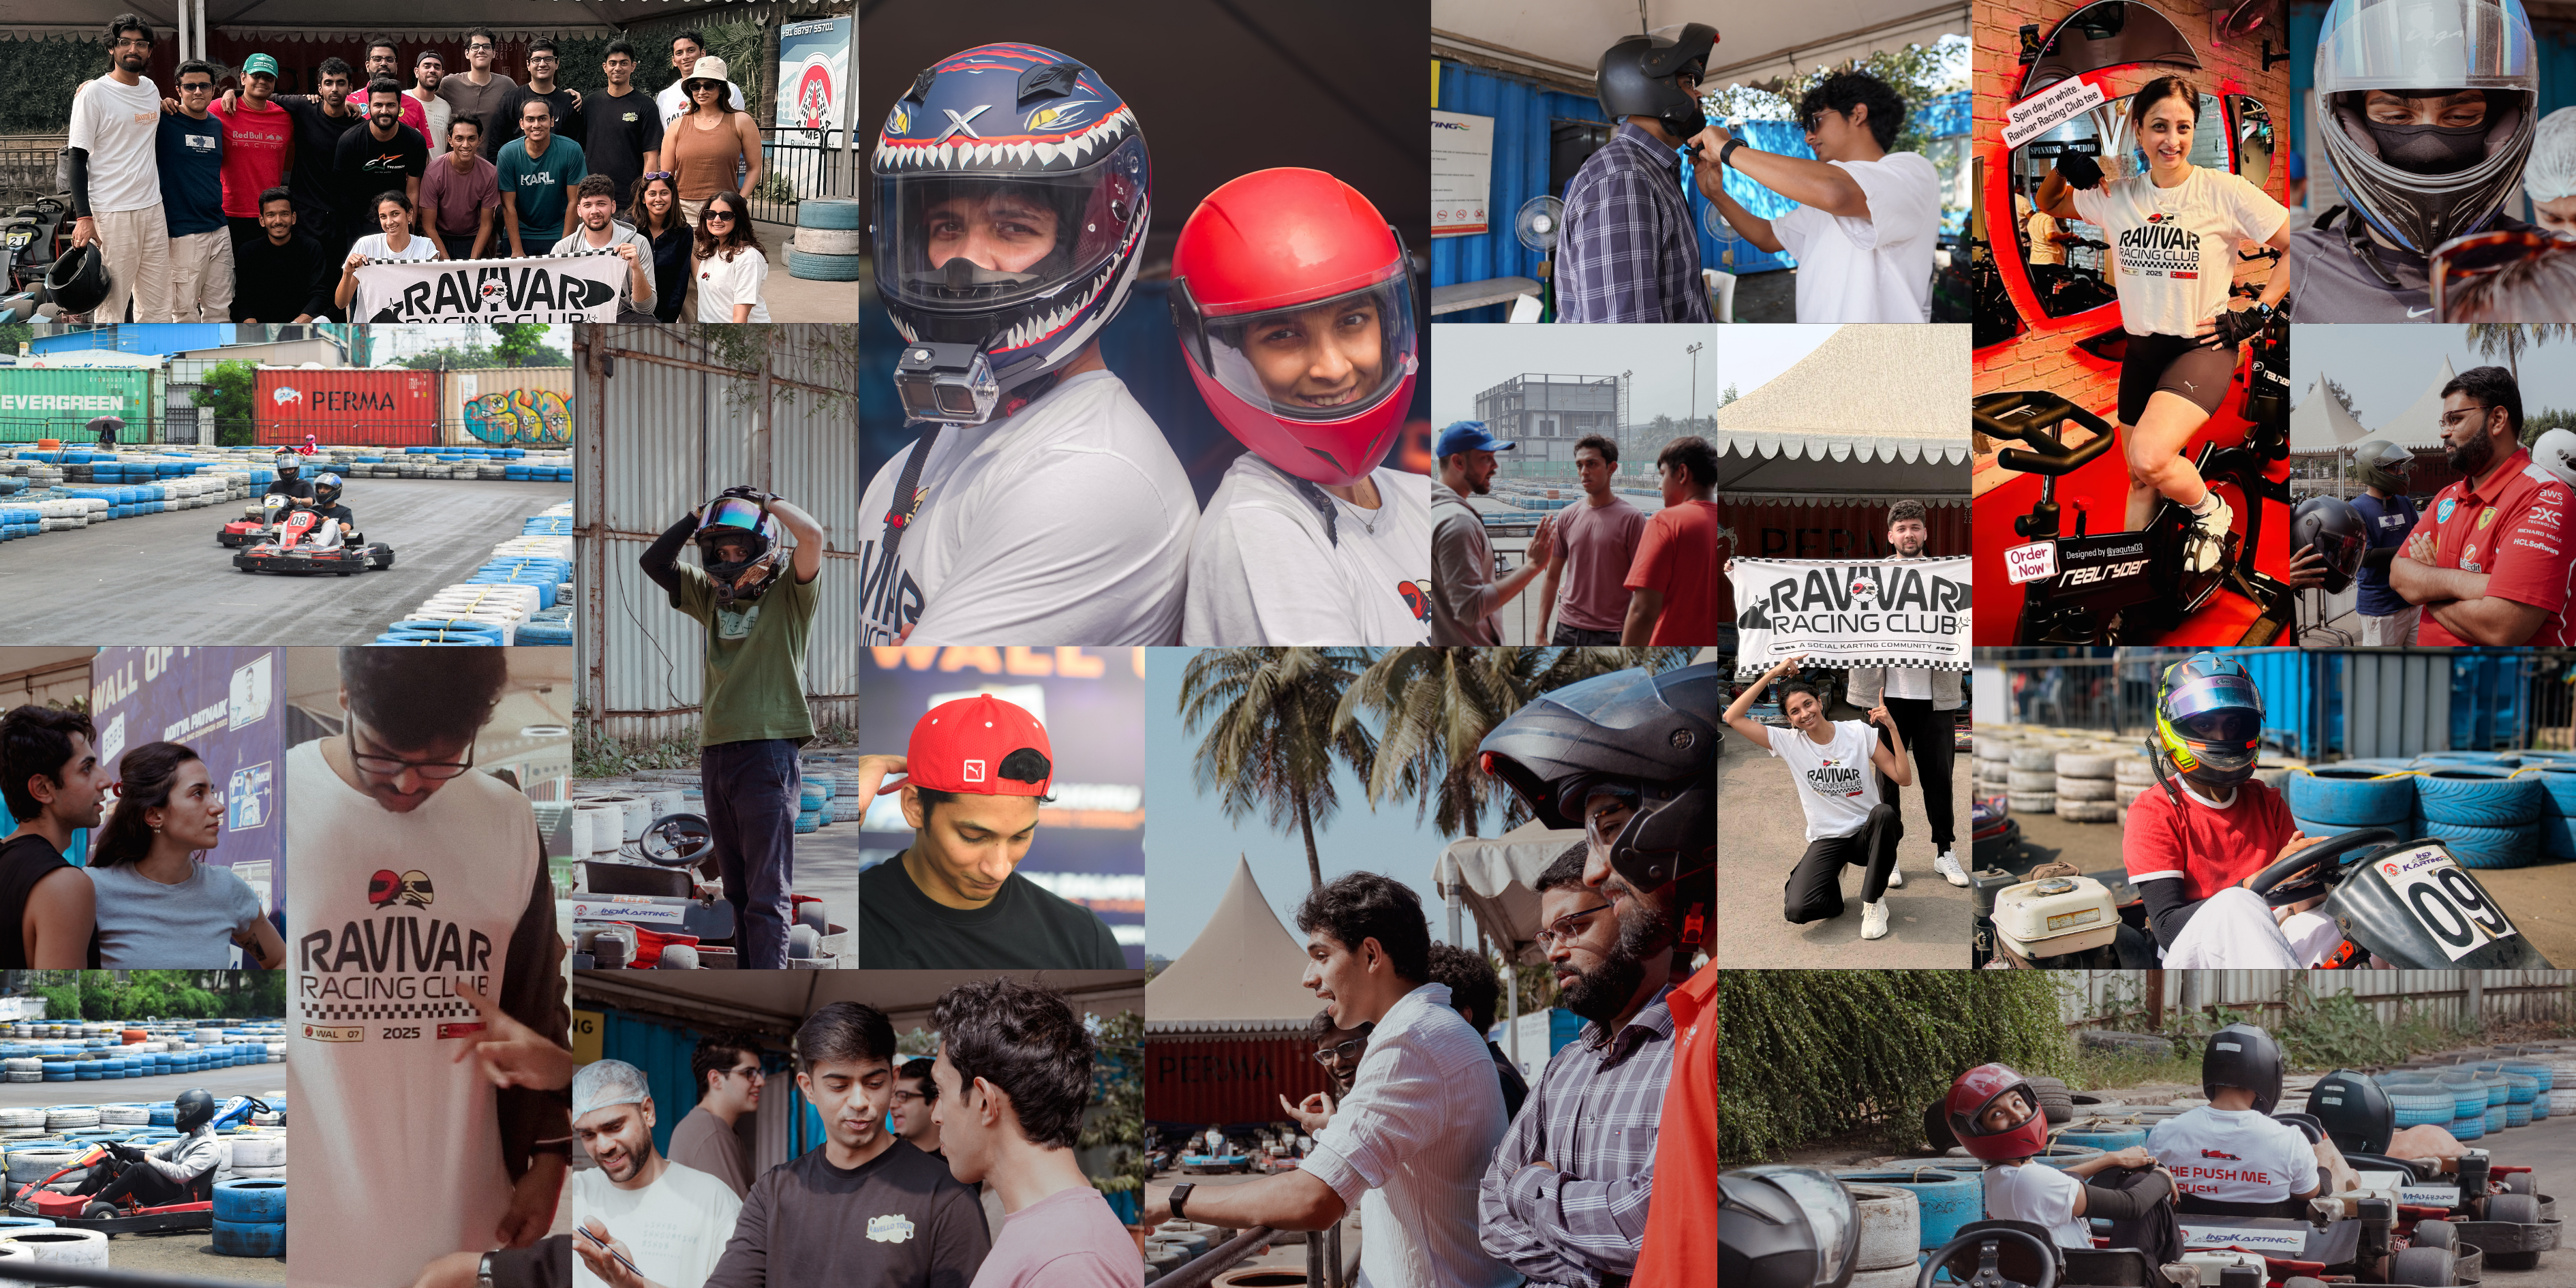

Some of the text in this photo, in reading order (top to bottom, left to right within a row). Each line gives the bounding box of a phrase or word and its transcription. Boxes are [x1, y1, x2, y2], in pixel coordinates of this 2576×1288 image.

[782, 22, 834, 37] +91 88797 55701
[232, 130, 263, 140] Red Bull
[2029, 145, 2061, 155] SPINNING
[520, 170, 555, 186] KARL
[10, 236, 27, 247] 21
[2119, 225, 2201, 251] RAVIVAR
[2119, 247, 2200, 262] RACING CLUB
[1, 395, 124, 411] EVERGREEN
[311, 391, 396, 411] PERMA
[2539, 489, 2563, 501] aws
[290, 516, 307, 526] 08
[2529, 506, 2563, 526] DXC
[2527, 519, 2560, 531] TECHNOLOGY
[2517, 528, 2562, 544] RICHARD MILLE
[1769, 566, 1959, 614] RAVIVAR
[1772, 613, 1957, 635] RACING CLUB
[91, 660, 138, 718] WALL
[164, 698, 228, 742] ADITYA PATNAIK
[195, 724, 216, 739] CHAMPION
[216, 718, 228, 730] 2023
[104, 723, 123, 753] 2023
[1807, 767, 1860, 783] RAVIVAR
[1808, 779, 1862, 789] RACING CLUB
[2408, 868, 2507, 948] 09
[301, 916, 492, 973] RAVIVAR
[300, 975, 416, 1000] RACING
[316, 1027, 421, 1040] WAL 07 2025
[1159, 1056, 1274, 1084] PERMA
[2169, 1165, 2271, 1186] HE PUSH ME,
[869, 1222, 913, 1233] RAVELLO TOUR
